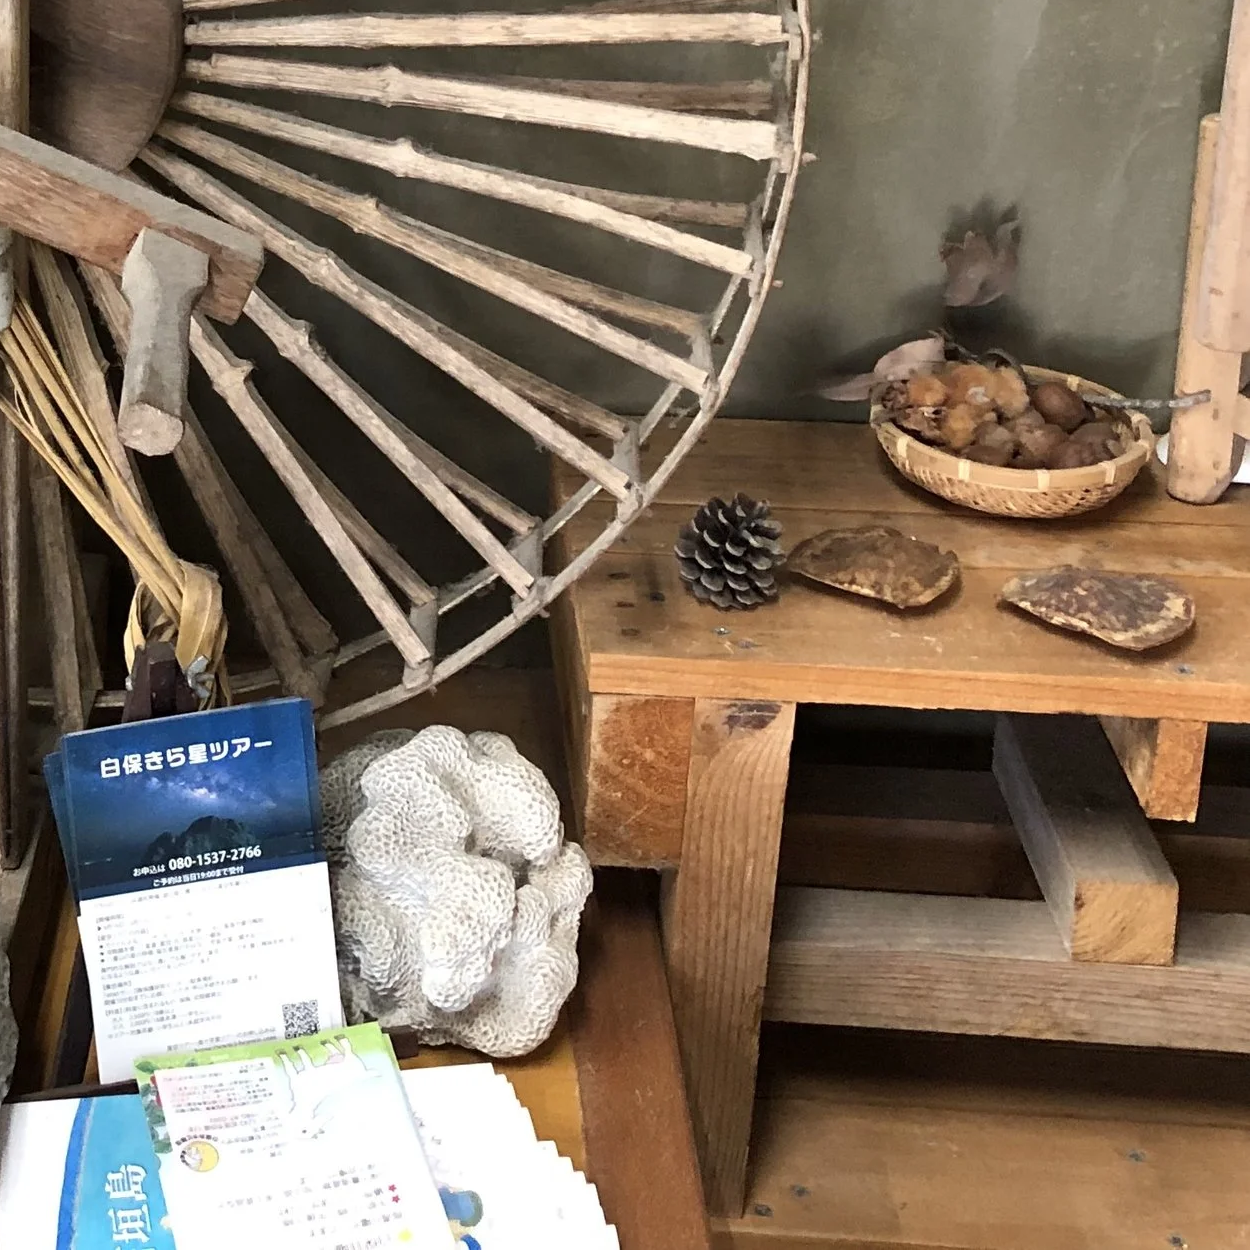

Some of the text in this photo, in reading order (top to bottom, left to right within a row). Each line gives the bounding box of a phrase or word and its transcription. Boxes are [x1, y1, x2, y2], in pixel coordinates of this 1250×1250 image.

[100, 737, 273, 778] 白保きら星ツアー
[133, 845, 262, 877] お申込は 080-1537-2766
[153, 866, 245, 887] ご予約は当日19:00まで受付
[105, 1164, 157, 1250] 垣島
